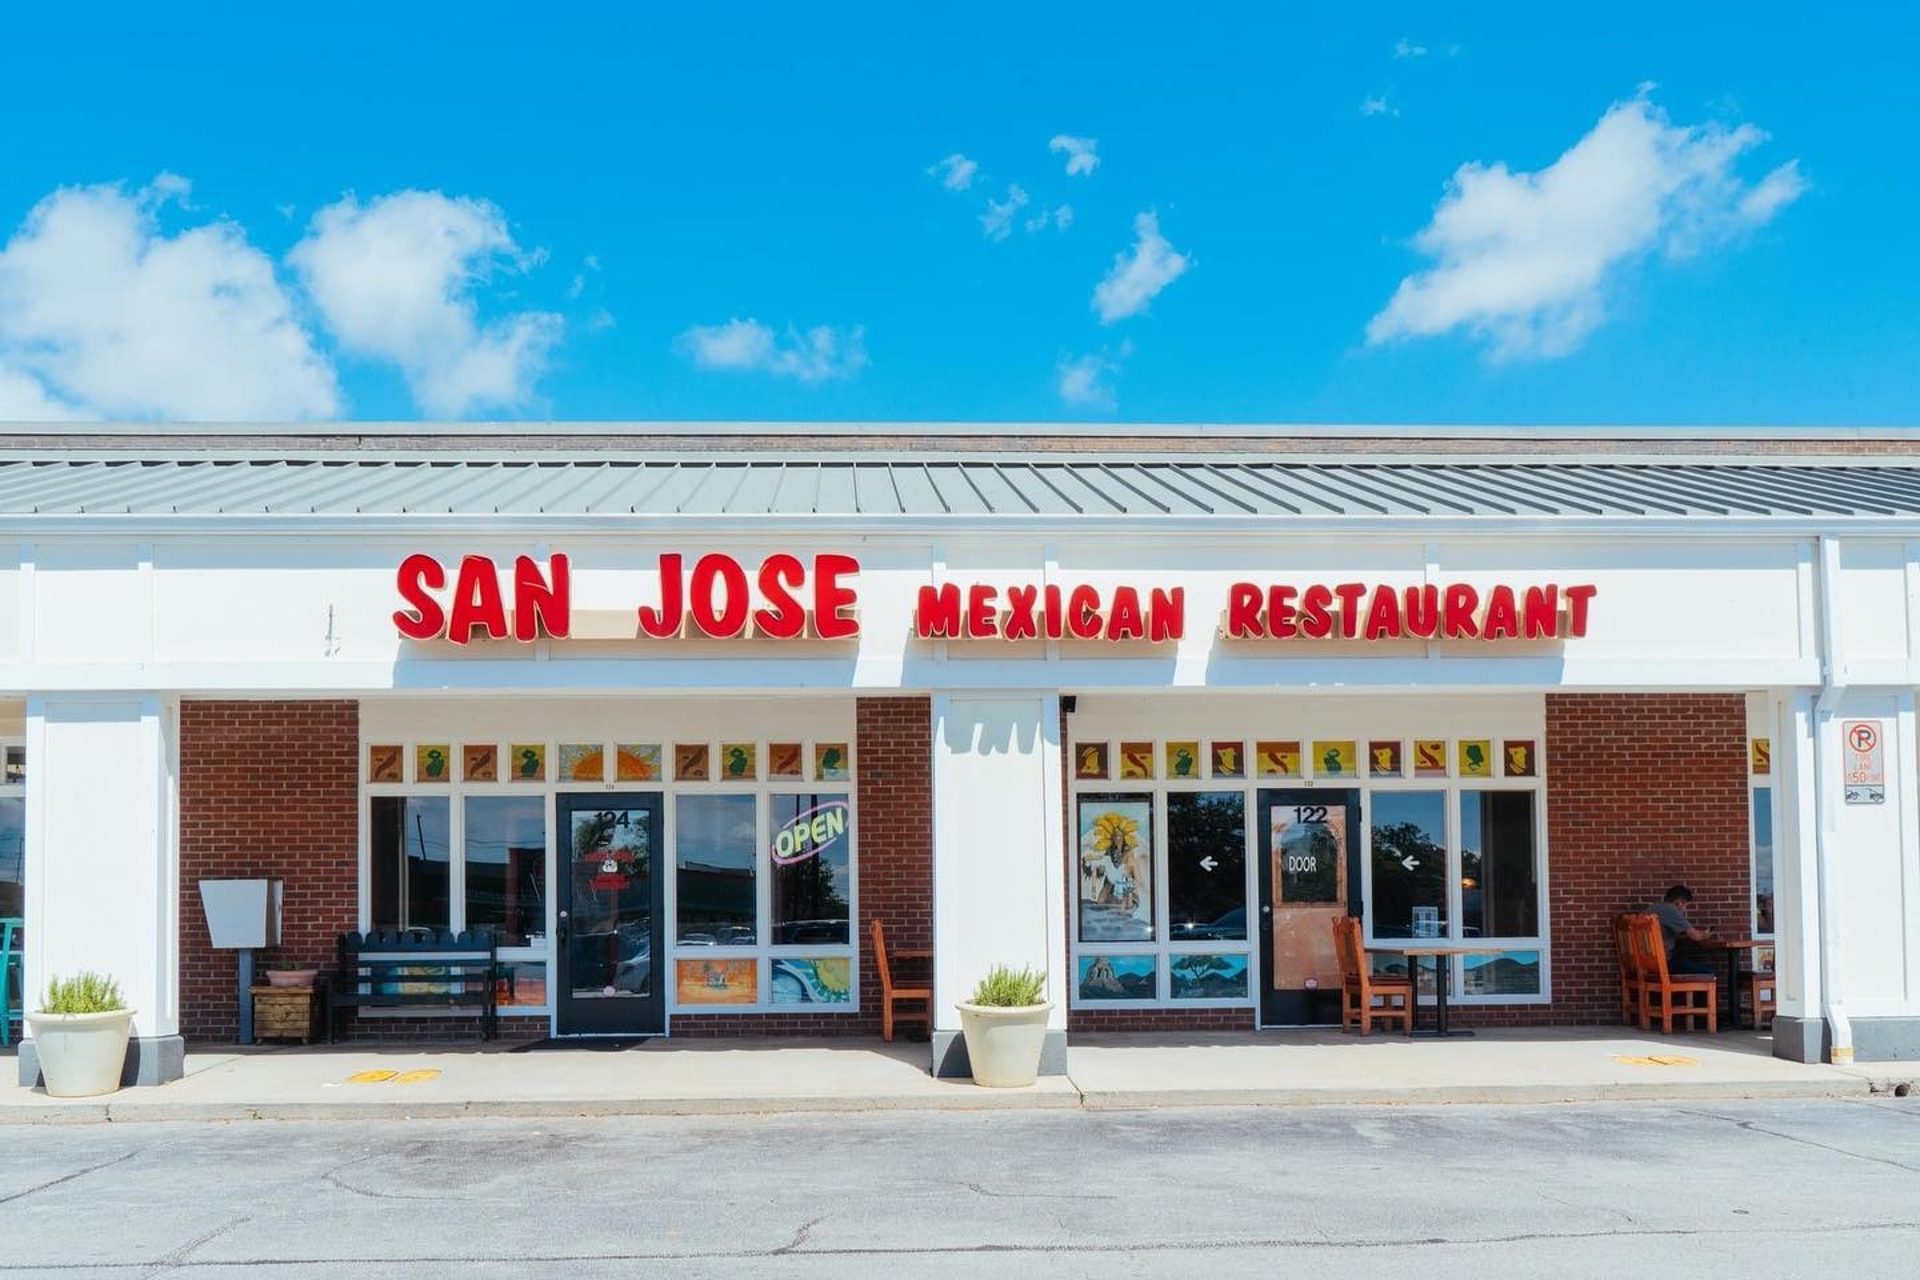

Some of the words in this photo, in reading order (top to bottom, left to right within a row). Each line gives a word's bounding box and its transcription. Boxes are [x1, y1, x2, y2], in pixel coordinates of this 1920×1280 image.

[393, 553, 569, 644] SAN
[638, 553, 860, 640] JOSE
[917, 583, 1185, 643] MEXICAN
[1228, 583, 1597, 642] RESTAURANT
[594, 811, 631, 829] 124
[1294, 807, 1328, 824] 122
[775, 808, 843, 858] OPEN
[1288, 856, 1317, 873] DOOR
